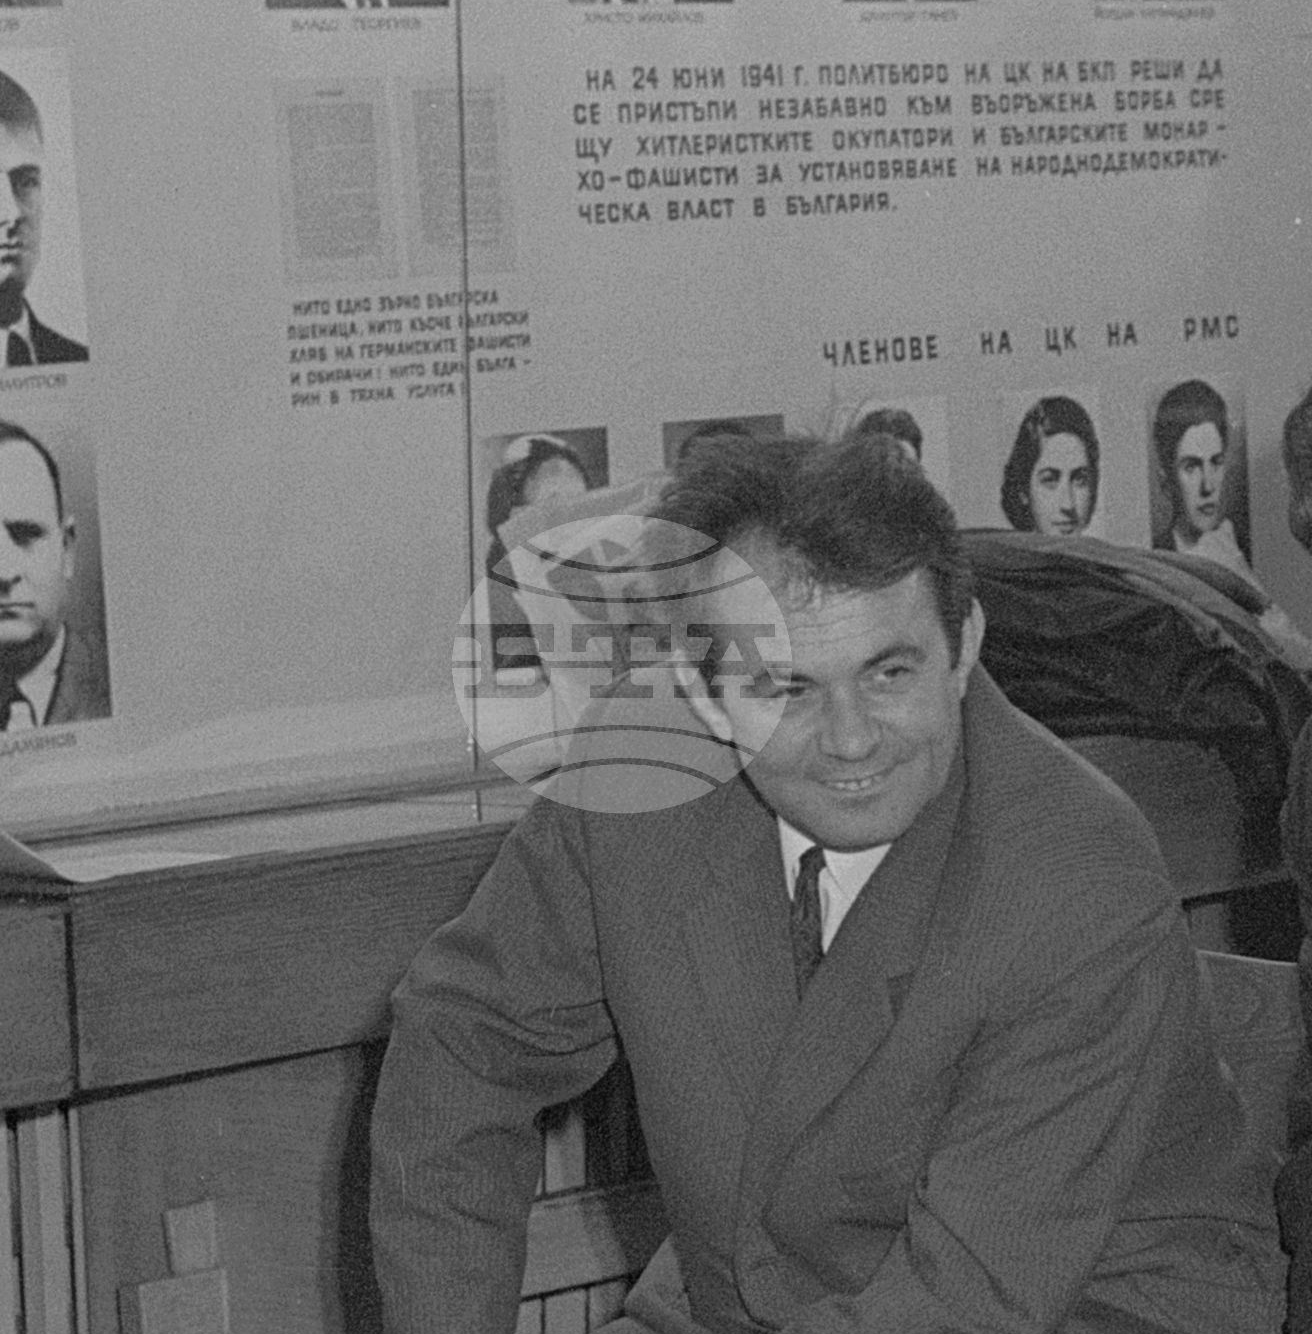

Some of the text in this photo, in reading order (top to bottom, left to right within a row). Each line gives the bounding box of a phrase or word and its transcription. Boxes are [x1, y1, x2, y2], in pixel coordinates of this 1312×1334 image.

[586, 68, 616, 91] НА
[632, 66, 659, 91] 24
[673, 67, 726, 90] ЮНИ
[741, 64, 784, 88] 1941
[818, 63, 950, 88] ПОЛИТБЮРО
[964, 63, 991, 85] НА
[1004, 62, 1031, 86] ЦК
[1043, 62, 1069, 83] НА
[1078, 60, 1117, 83] БКП
[1130, 59, 1185, 82] РЕШИ
[1197, 58, 1224, 82] ДА
[573, 87, 1226, 125] СЕ ПРИСТЪПИ НЕЗАБАВНО КЪМ ВЪОРЪЖЕНА БОРБА СРЕ
[575, 136, 613, 164] ЩУ
[635, 130, 814, 158] ХИТЛЕРИСТКИТЕ
[832, 127, 954, 152] ОКУПАТОРИ
[972, 126, 987, 147] И
[1000, 122, 1130, 147] БЪЛГАРСКИТЕ
[577, 164, 739, 193] ХО-ФАШИСТИ
[755, 163, 784, 186] ЗА
[798, 157, 958, 184] УСТАНОВЯВАНЕ
[976, 155, 1002, 178] НА
[579, 192, 899, 225] ЧЕСКА ВЛАСТ В БЪЛГАРИЯ.
[293, 299, 330, 316] НИТО
[336, 296, 372, 315] ЕДНО
[378, 293, 420, 313] ЗЪРНО
[367, 318, 403, 336] НИТО
[822, 315, 1240, 368] ЧЛЕНОВЕ НА ЦК НА РМС
[289, 345, 327, 365] ХЛЯБ
[334, 344, 355, 362] НА
[359, 337, 458, 360] ГЕРМАНСКИТЕ
[290, 371, 301, 387] И
[390, 363, 426, 380] НИТО
[291, 390, 321, 407] РИН
[329, 389, 340, 406] В
